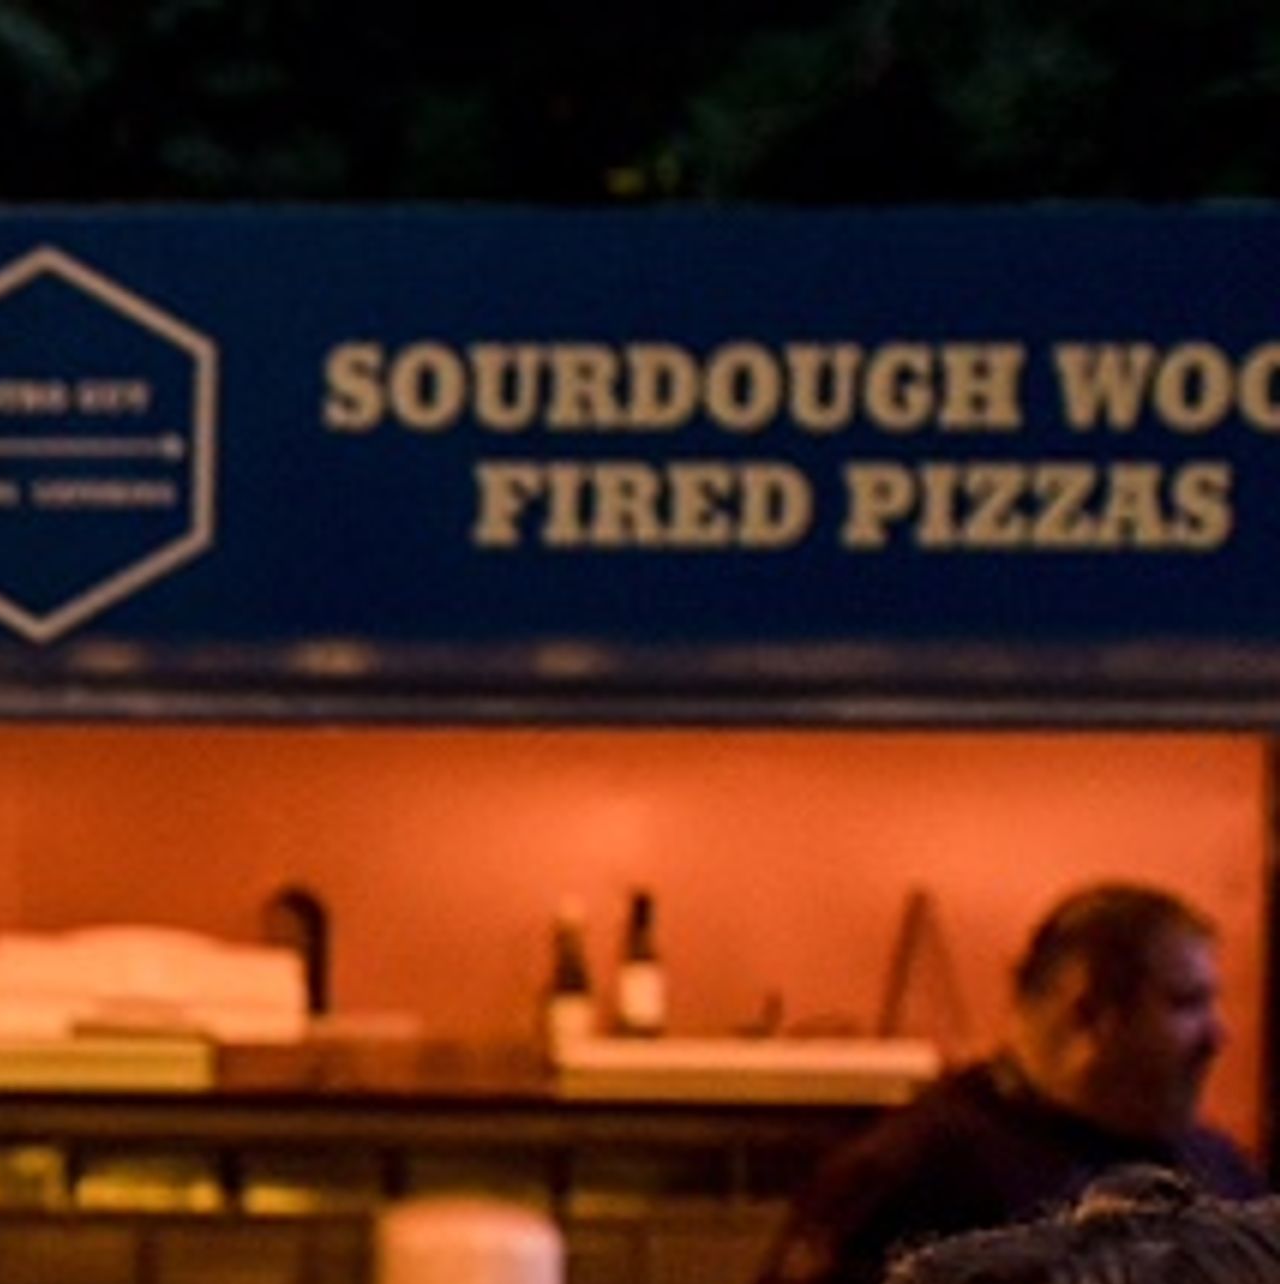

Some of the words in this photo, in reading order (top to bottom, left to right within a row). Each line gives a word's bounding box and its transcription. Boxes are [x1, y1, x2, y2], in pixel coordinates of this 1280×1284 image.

[325, 343, 1024, 429] SOURDOUGH
[474, 463, 812, 547] FIRED
[843, 463, 1232, 549] PIZZAS
